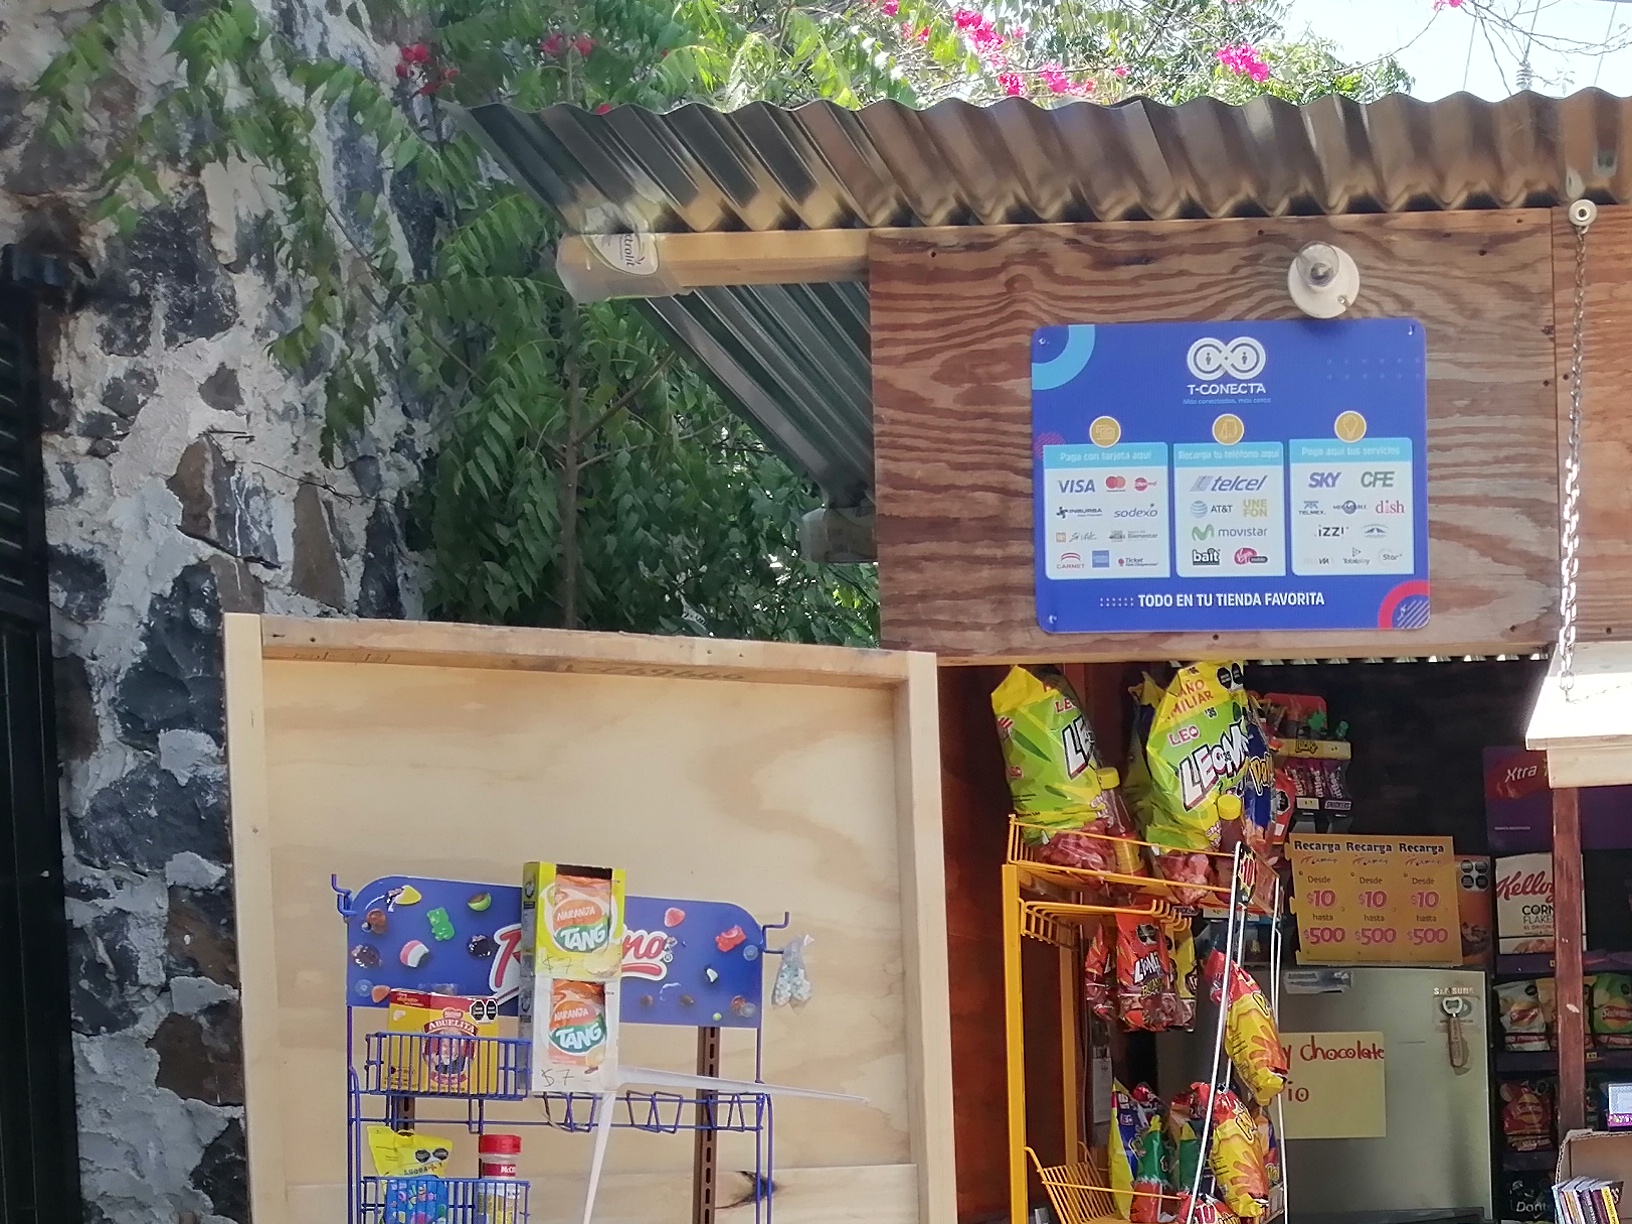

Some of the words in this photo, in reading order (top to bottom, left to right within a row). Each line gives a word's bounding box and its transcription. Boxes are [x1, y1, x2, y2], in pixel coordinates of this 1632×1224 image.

[1187, 383, 1266, 395] T-CONECTA
[1058, 479, 1096, 493] VISA
[1211, 475, 1268, 492] telcel
[1308, 472, 1341, 488] SKY
[1361, 471, 1395, 488] CFE
[1210, 504, 1233, 513] AT&T
[1243, 499, 1267, 508] UNE
[1376, 500, 1405, 514] dish
[1114, 505, 1158, 518] sodexo
[1244, 508, 1267, 517] FON
[1218, 526, 1267, 537] movistar
[1193, 550, 1220, 563] bait
[1139, 594, 1173, 608] TODO
[1176, 593, 1193, 607] EN
[1196, 593, 1213, 607] TU
[1216, 593, 1261, 607] TIENDA
[1265, 592, 1325, 607] FAVORITA
[1168, 726, 1199, 746] LEO
[1504, 764, 1538, 783] Xtra
[1294, 840, 1341, 853] Recarga
[1346, 841, 1392, 854] Recarga
[1399, 843, 1444, 855] Recarga
[1308, 876, 1331, 884] Desde
[1359, 877, 1383, 885] Desde
[1412, 877, 1435, 885] Desde
[1307, 890, 1336, 908] $10
[1358, 891, 1388, 908] $10
[1411, 891, 1440, 908] $10
[556, 905, 596, 921] NARANJA
[1364, 914, 1385, 922] hasta
[560, 924, 606, 951] TANG
[1303, 927, 1346, 945] $500
[1355, 928, 1397, 945] $500
[1407, 928, 1449, 945] $500
[554, 1008, 589, 1021] NARANJA
[428, 1019, 475, 1033] ABUELITA
[555, 1023, 601, 1049] TANG
